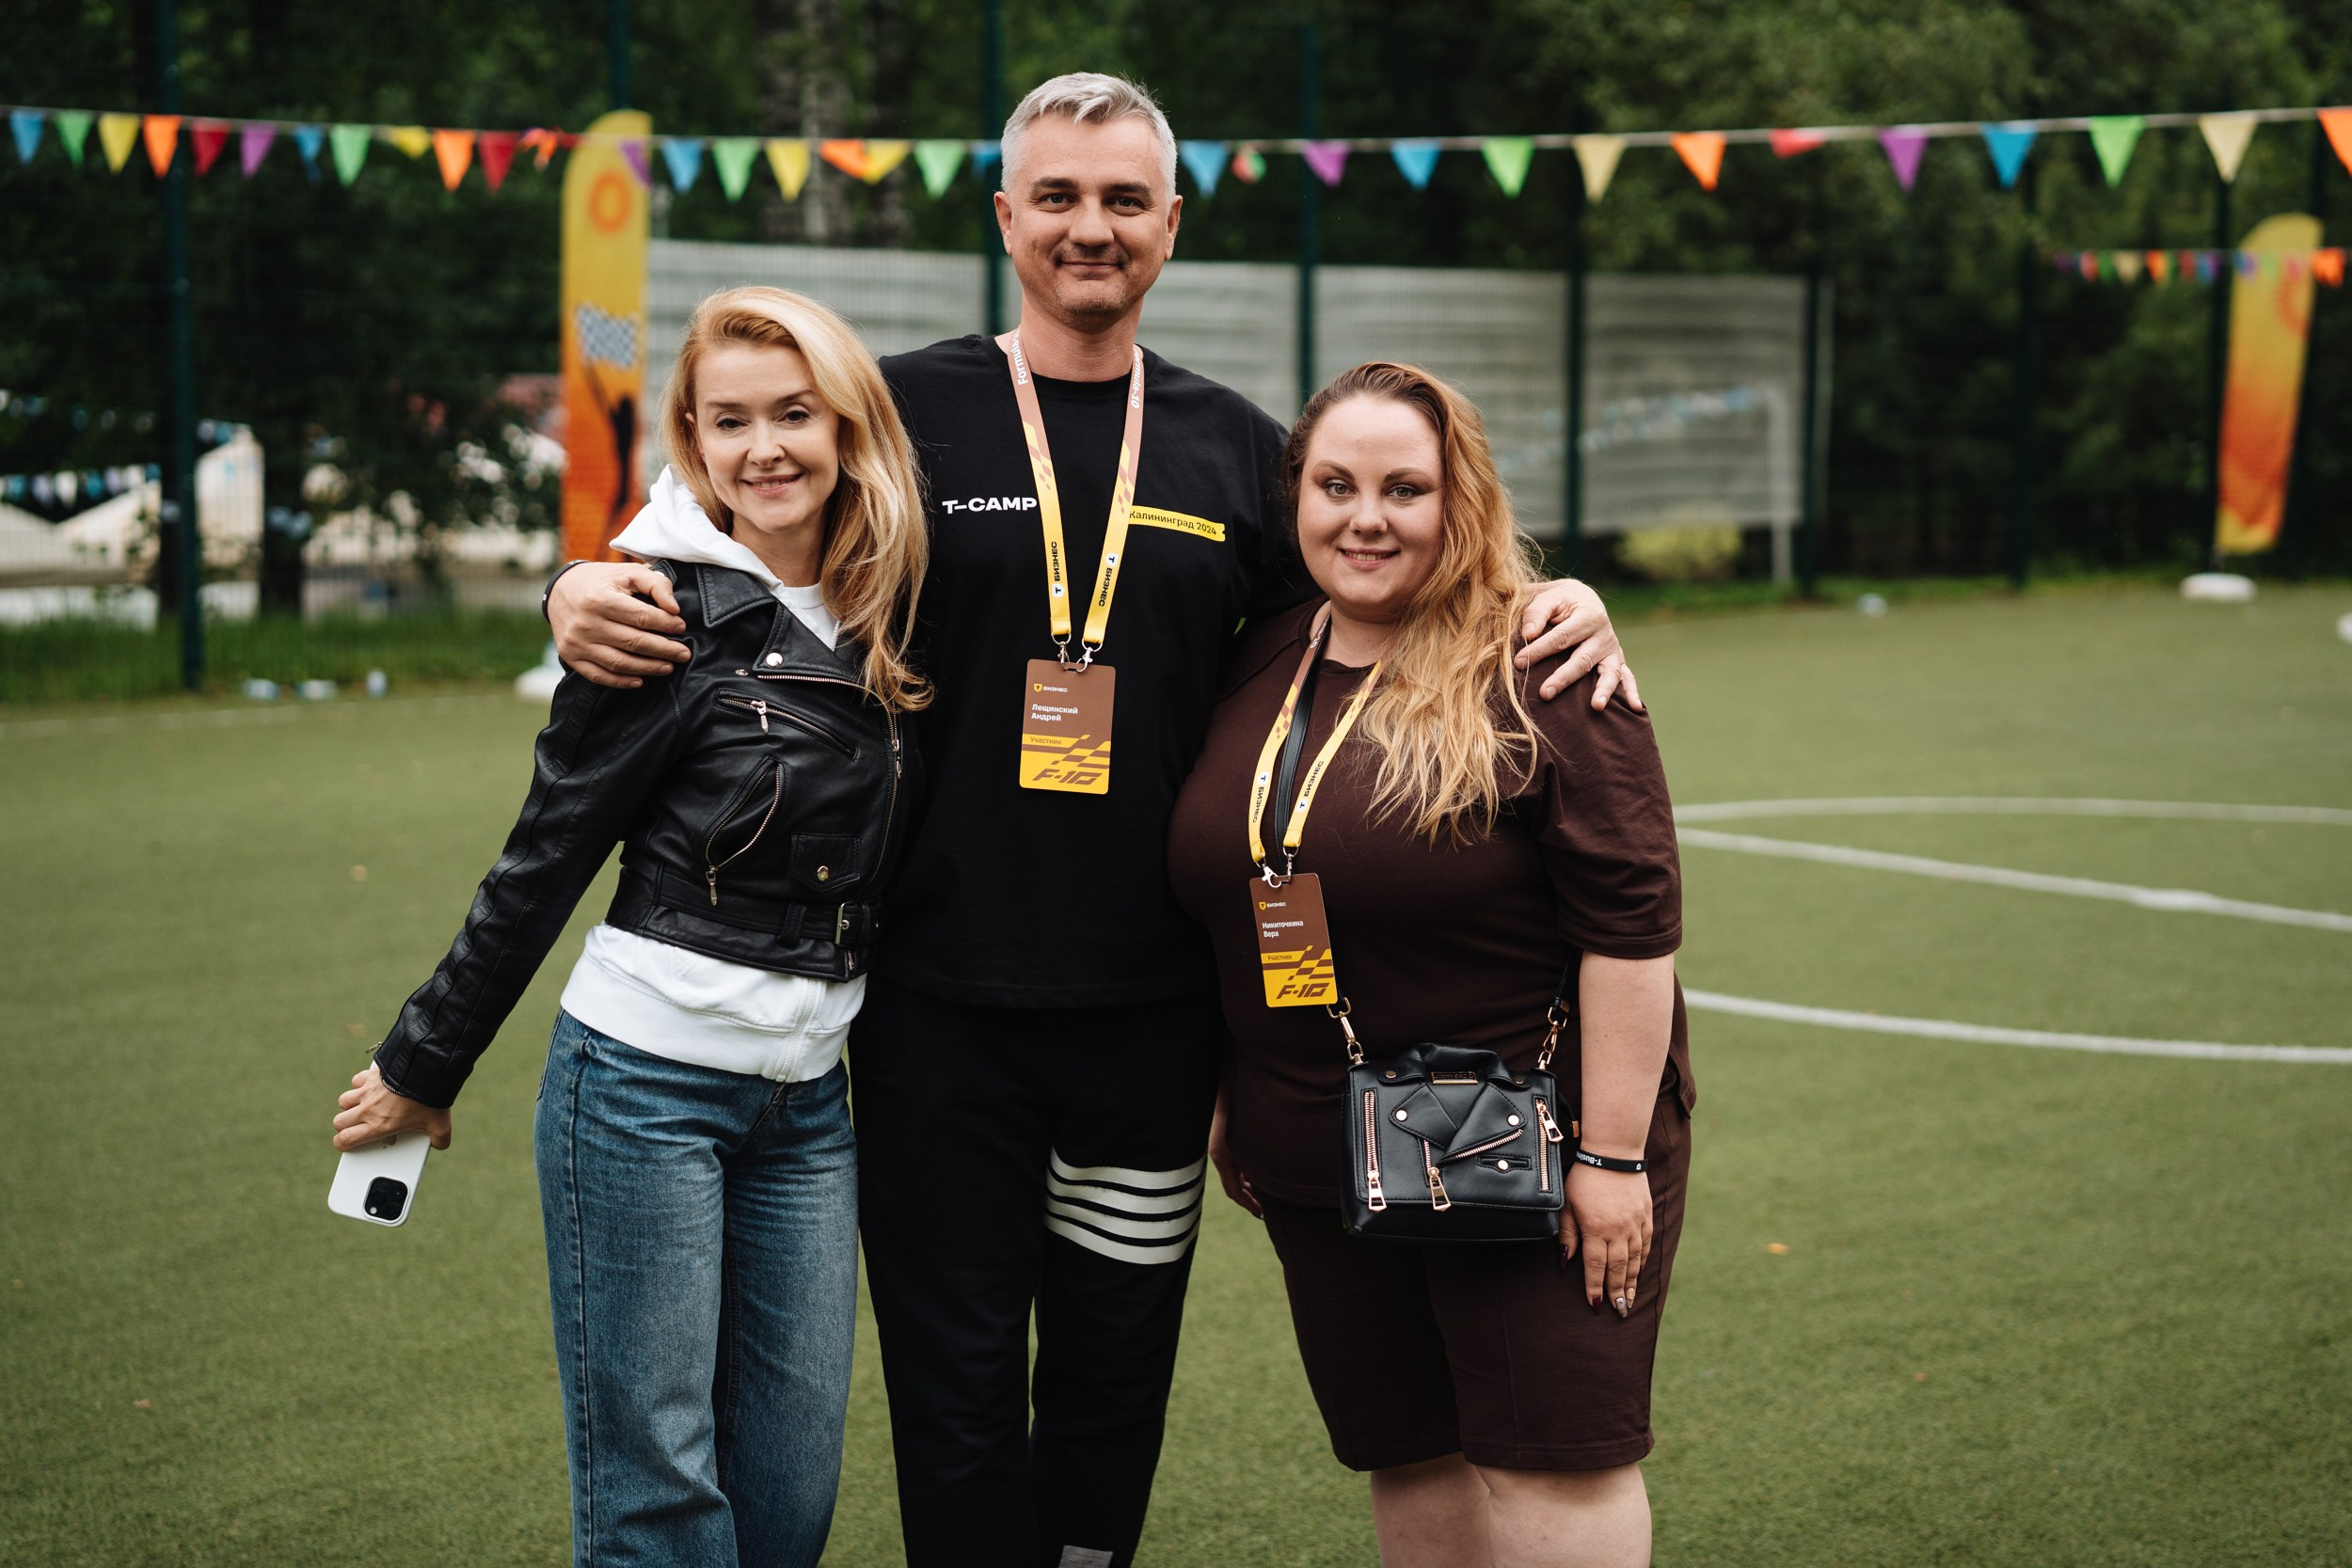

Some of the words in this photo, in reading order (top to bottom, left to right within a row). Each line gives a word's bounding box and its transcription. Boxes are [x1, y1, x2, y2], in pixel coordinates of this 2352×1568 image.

[942, 497, 1038, 515] T-CAMP
[1129, 511, 1194, 530] Калининград
[1196, 521, 1217, 535] 2024
[1051, 541, 1060, 581] БИЗНЕС
[1098, 567, 1113, 607] БИЗНЕС
[1031, 704, 1078, 715] Лещинский
[1031, 712, 1062, 721] Андрей
[1030, 736, 1062, 745] Участник
[1032, 768, 1103, 785] F-10
[1303, 760, 1325, 797] БИЗНЕС
[1252, 786, 1264, 823] БИЗНЕС
[1262, 920, 1304, 929] Никиточкина
[1277, 982, 1330, 999] F-10
